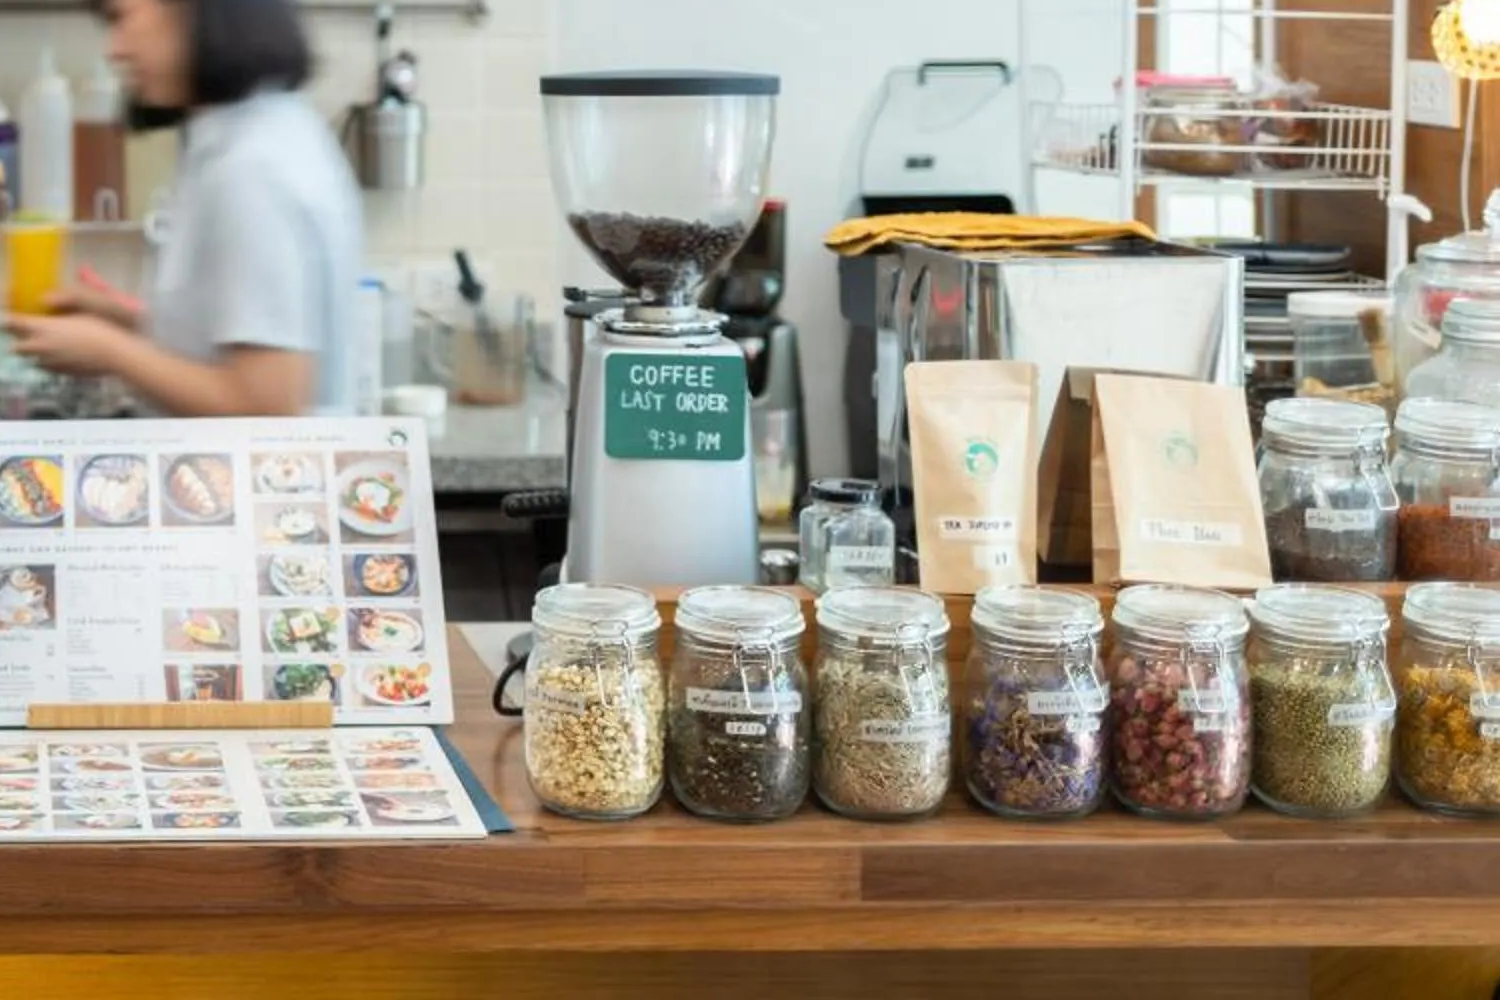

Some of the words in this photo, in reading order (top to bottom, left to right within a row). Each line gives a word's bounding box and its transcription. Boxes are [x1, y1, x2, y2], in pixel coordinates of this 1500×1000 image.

[630, 365, 715, 388] COFFEE
[621, 390, 666, 412] LAST
[676, 392, 728, 413] ORDER
[696, 431, 721, 450] PM
